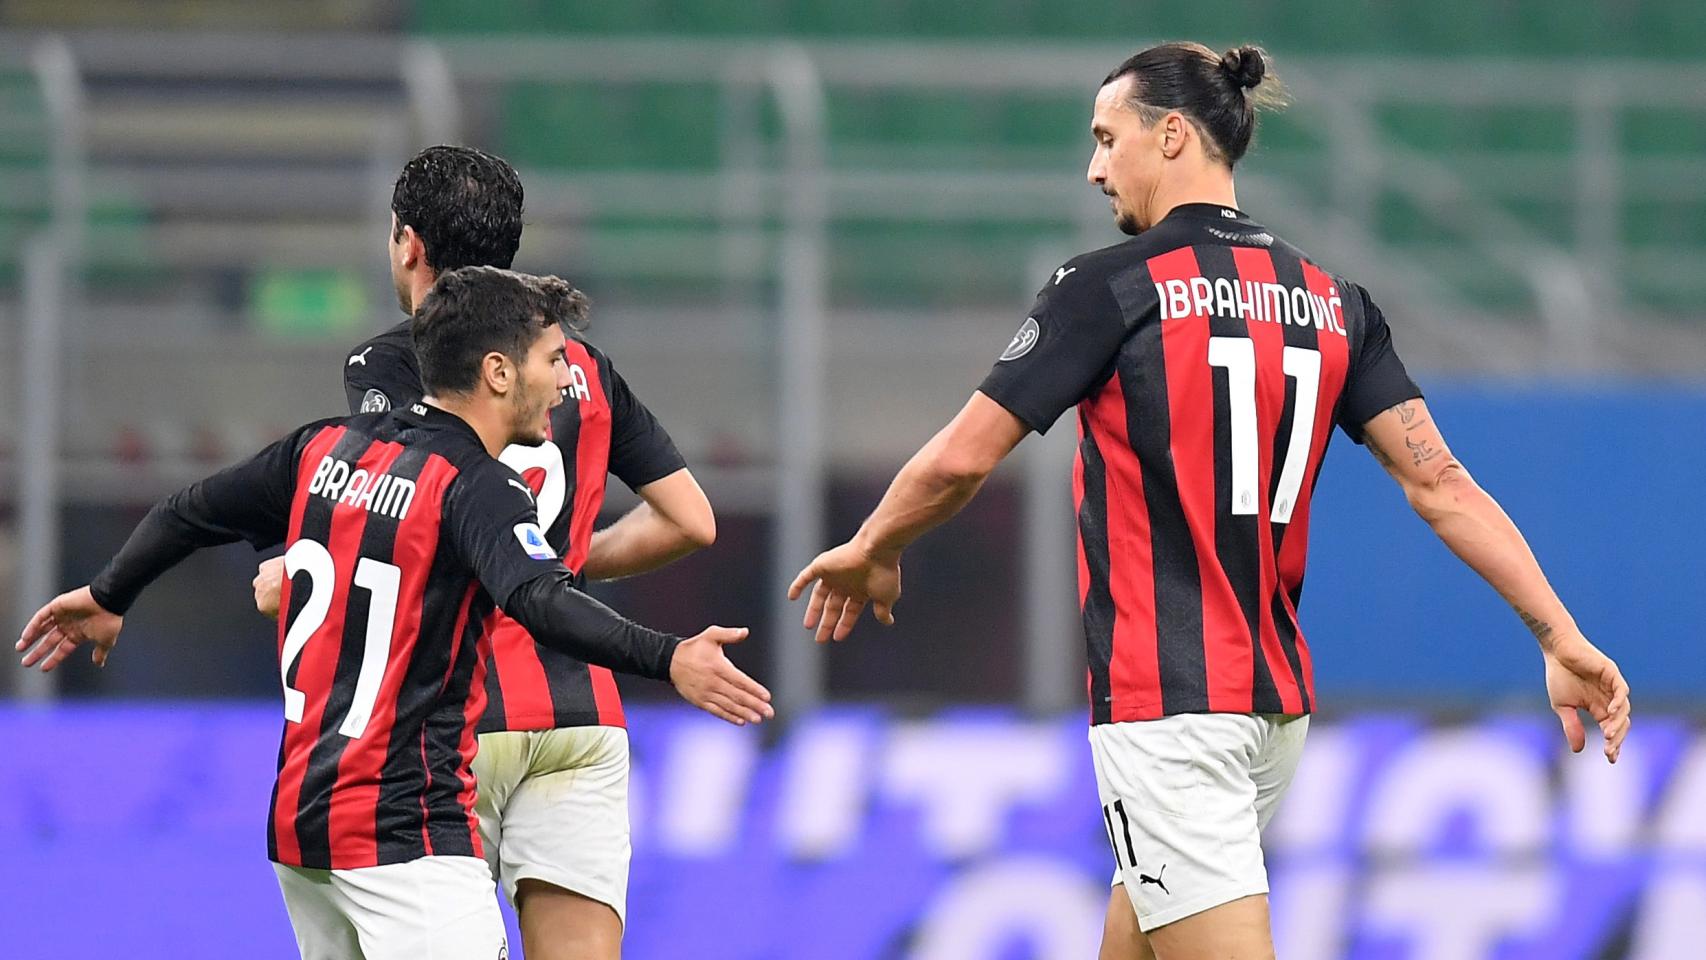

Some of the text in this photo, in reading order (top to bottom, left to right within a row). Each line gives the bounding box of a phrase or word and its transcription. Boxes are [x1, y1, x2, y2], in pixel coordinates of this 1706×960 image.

[1155, 277, 1347, 337] IBRAHIMOVIĆ
[1208, 336, 1322, 524] 11
[308, 455, 416, 520] BRAHIM
[280, 538, 402, 740] 21
[1103, 799, 1137, 871] 11
